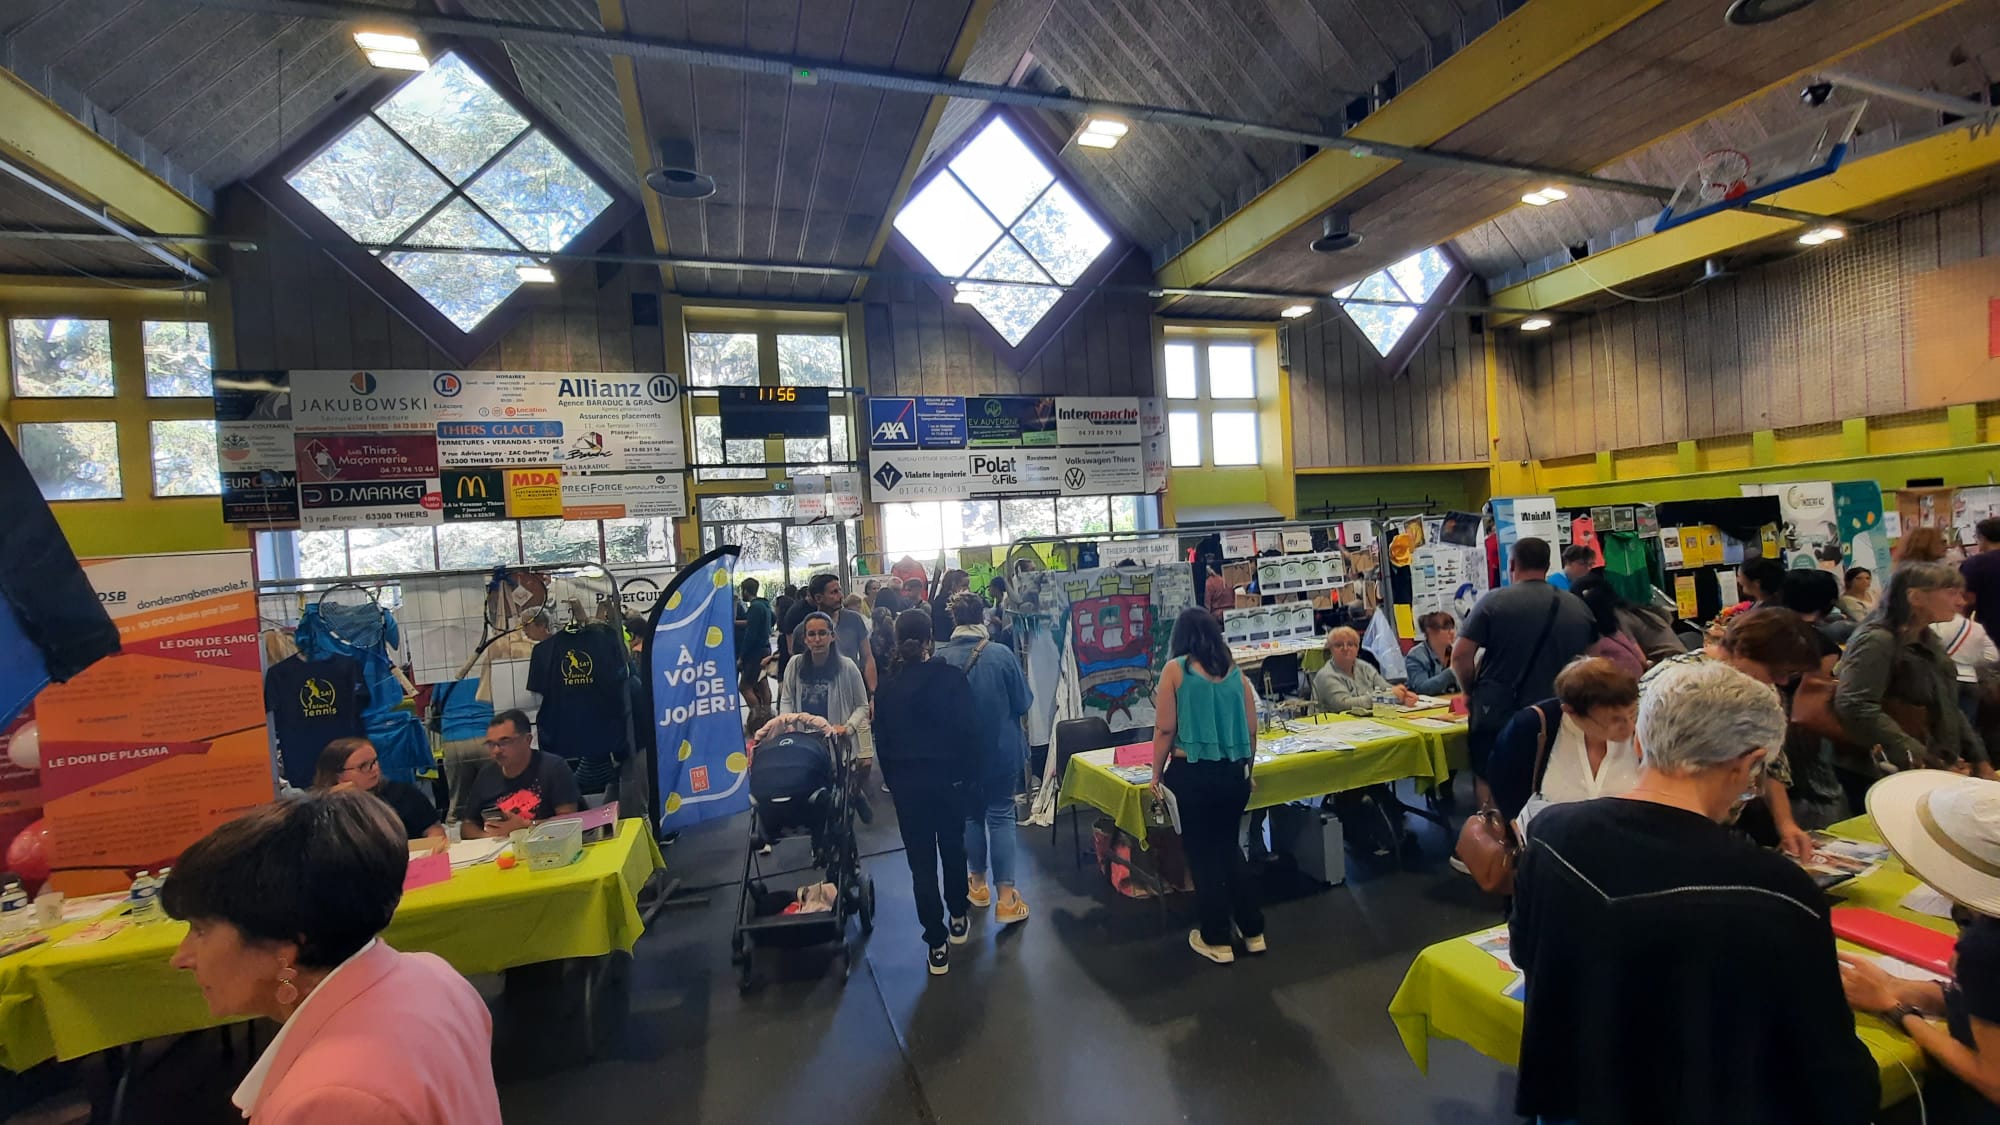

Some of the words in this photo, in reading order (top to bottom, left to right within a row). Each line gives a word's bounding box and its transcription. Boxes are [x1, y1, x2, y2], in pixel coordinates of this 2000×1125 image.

[558, 378, 642, 397] Allianz
[300, 397, 428, 412] JAKUBOWSKI
[621, 413, 662, 421] placements
[1058, 408, 1138, 421] Intermarché
[442, 424, 486, 435] THIERS
[492, 424, 536, 435] GLACE
[873, 421, 909, 440] AXA
[362, 445, 398, 455] Thiers
[338, 454, 408, 467] Maçonnerie
[973, 456, 1016, 473] Polat
[1065, 457, 1111, 466] Volkswagen
[512, 473, 559, 486] MDA
[905, 471, 931, 479] Vialatte
[330, 485, 425, 502] D.MARKET
[394, 511, 429, 519] THIERS
[137, 579, 249, 610] dondesangbenevole.fr
[160, 639, 175, 649] LE
[177, 637, 204, 648] DON
[206, 636, 222, 646] DE
[224, 634, 256, 644] SANG
[195, 649, 232, 658] TOTAL
[676, 644, 694, 666] À
[664, 660, 717, 687] VOUS
[563, 676, 594, 686] Tennis
[696, 677, 725, 698] DE
[303, 706, 337, 718] Tennis
[48, 758, 65, 769] LE
[68, 755, 97, 766] DON
[100, 752, 117, 763] DE
[119, 746, 169, 760] PLASMA
